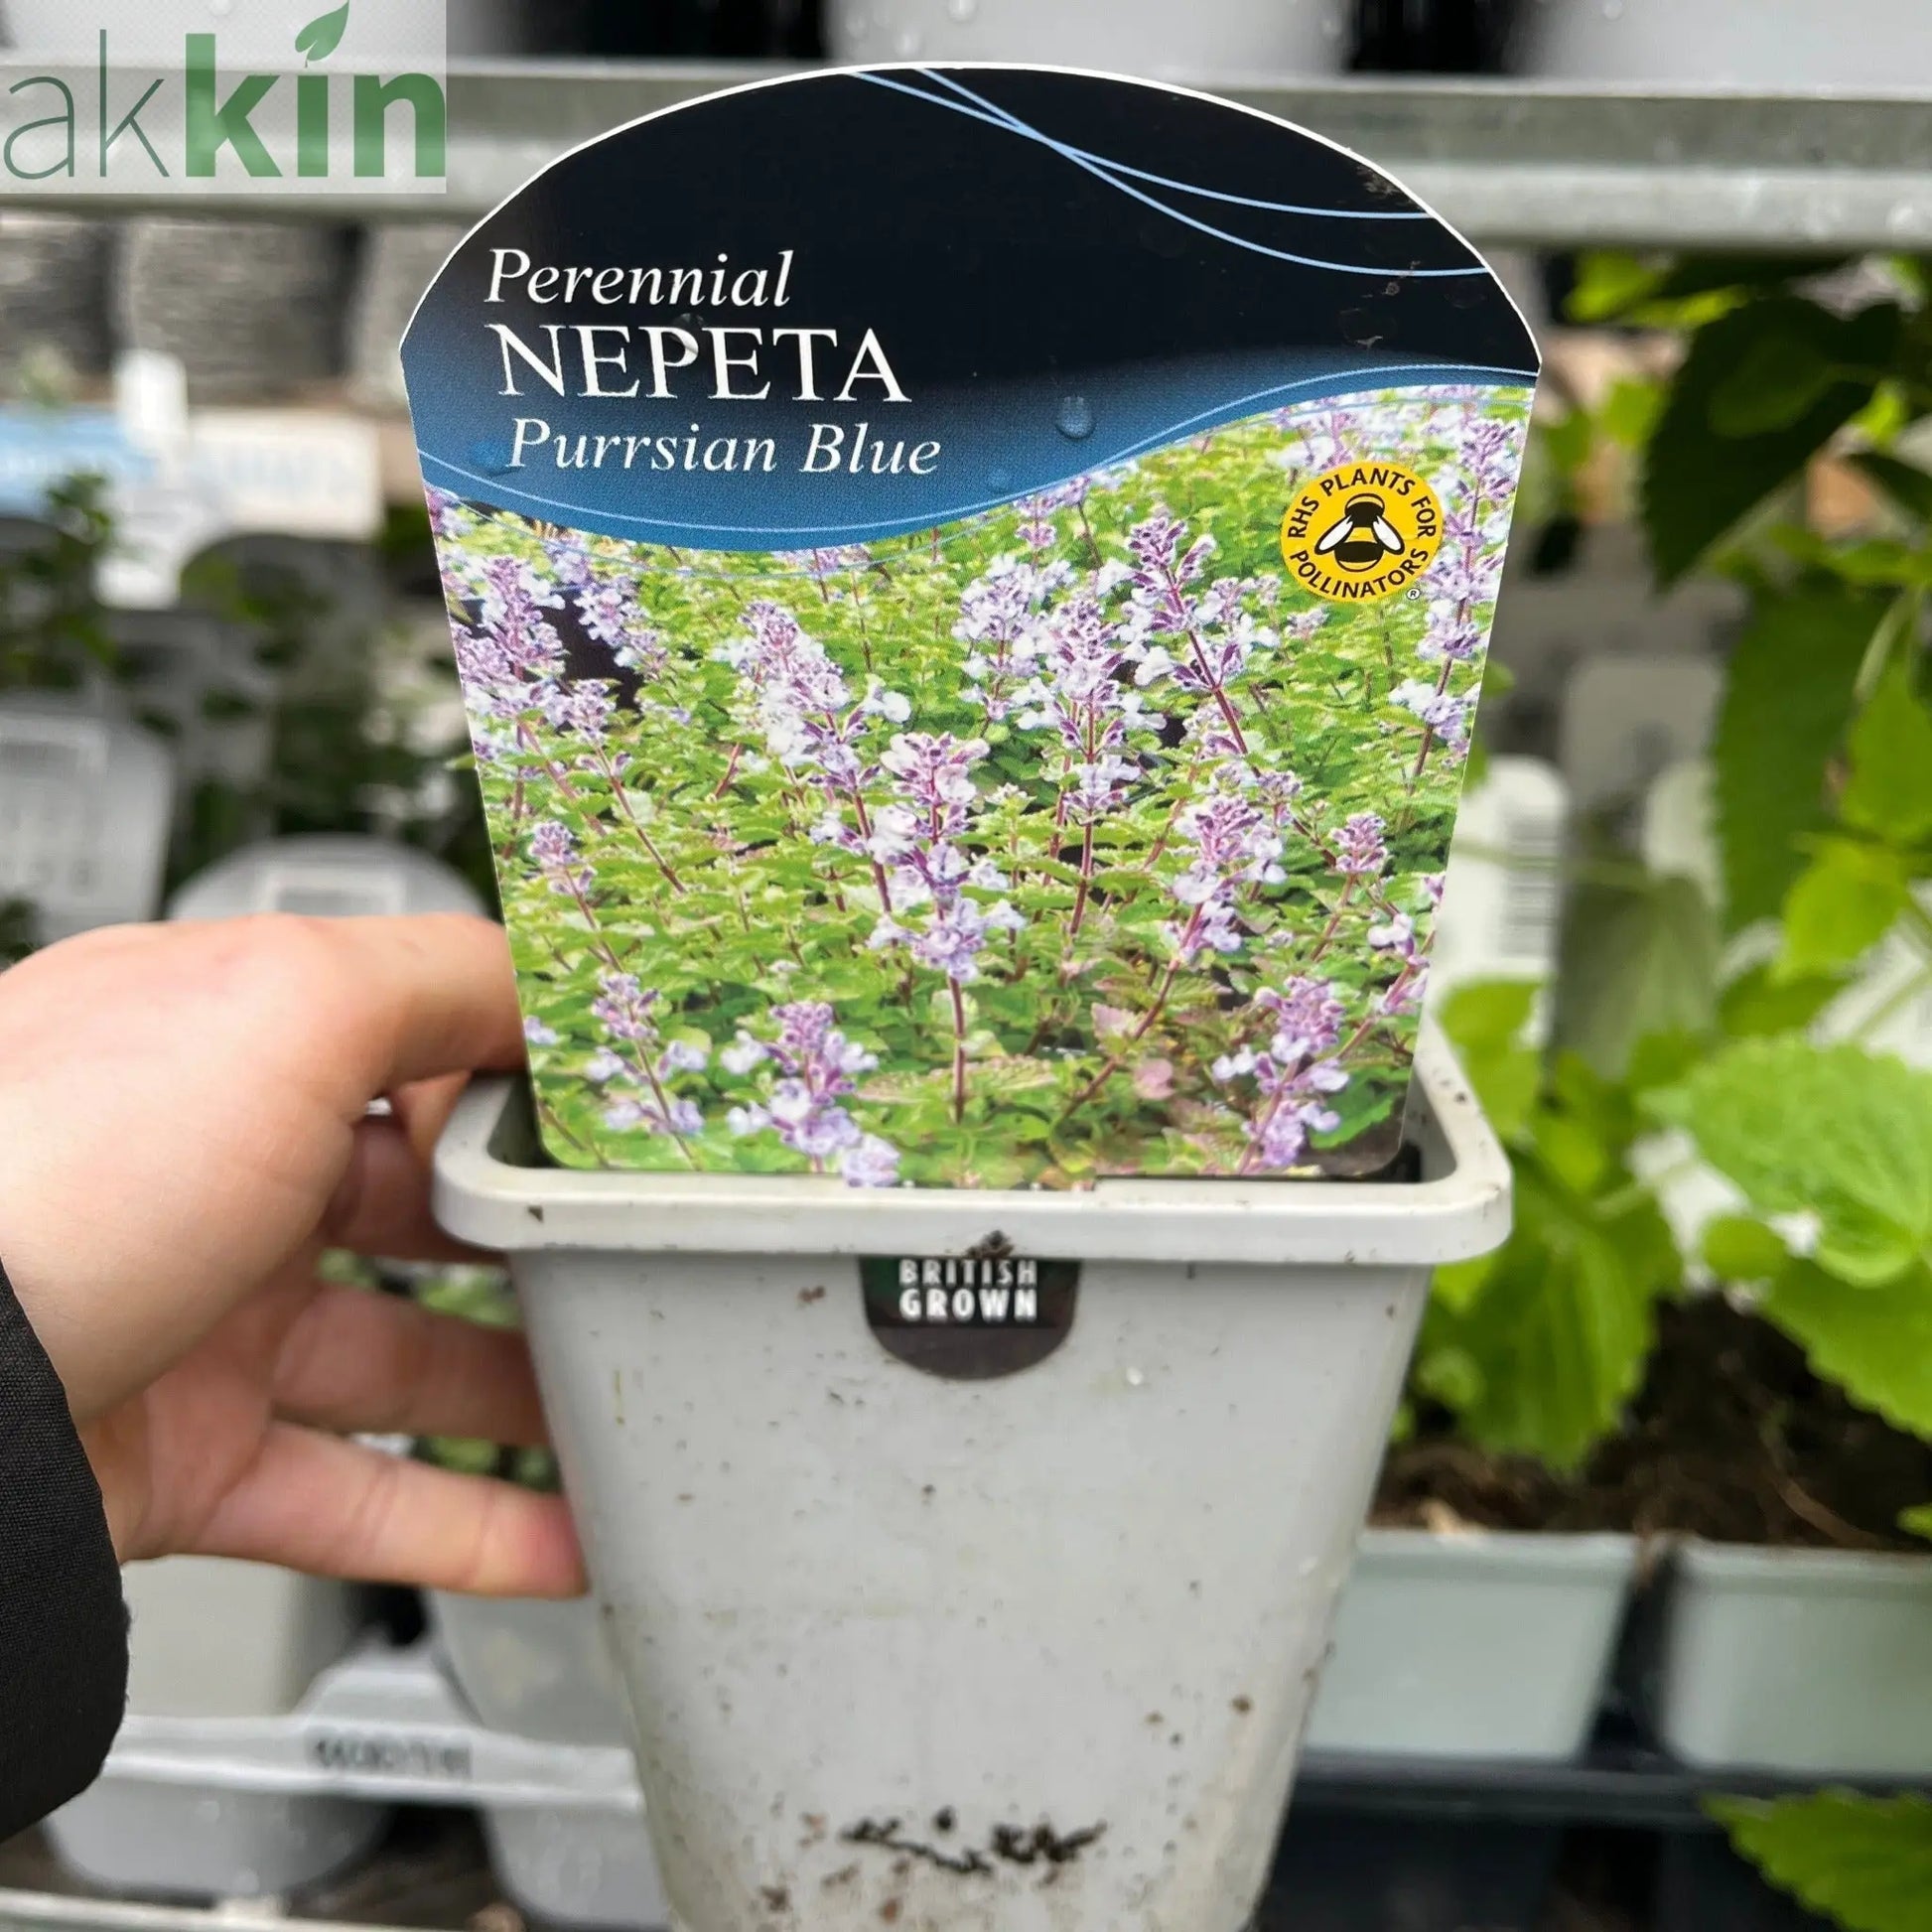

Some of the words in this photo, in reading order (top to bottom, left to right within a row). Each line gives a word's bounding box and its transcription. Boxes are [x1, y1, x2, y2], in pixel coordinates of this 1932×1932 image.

[484, 248, 794, 307] Perennial
[484, 324, 912, 403] NEPETA
[506, 418, 777, 472] Purrsian
[799, 423, 941, 475] Blue
[1288, 495, 1319, 538] RHS
[1319, 468, 1415, 496] PLANTS
[1411, 495, 1437, 539] FOR
[1290, 548, 1429, 599] POLLINATORS
[899, 1258, 1037, 1287] BRITISH
[899, 1289, 1037, 1321] GROWN
